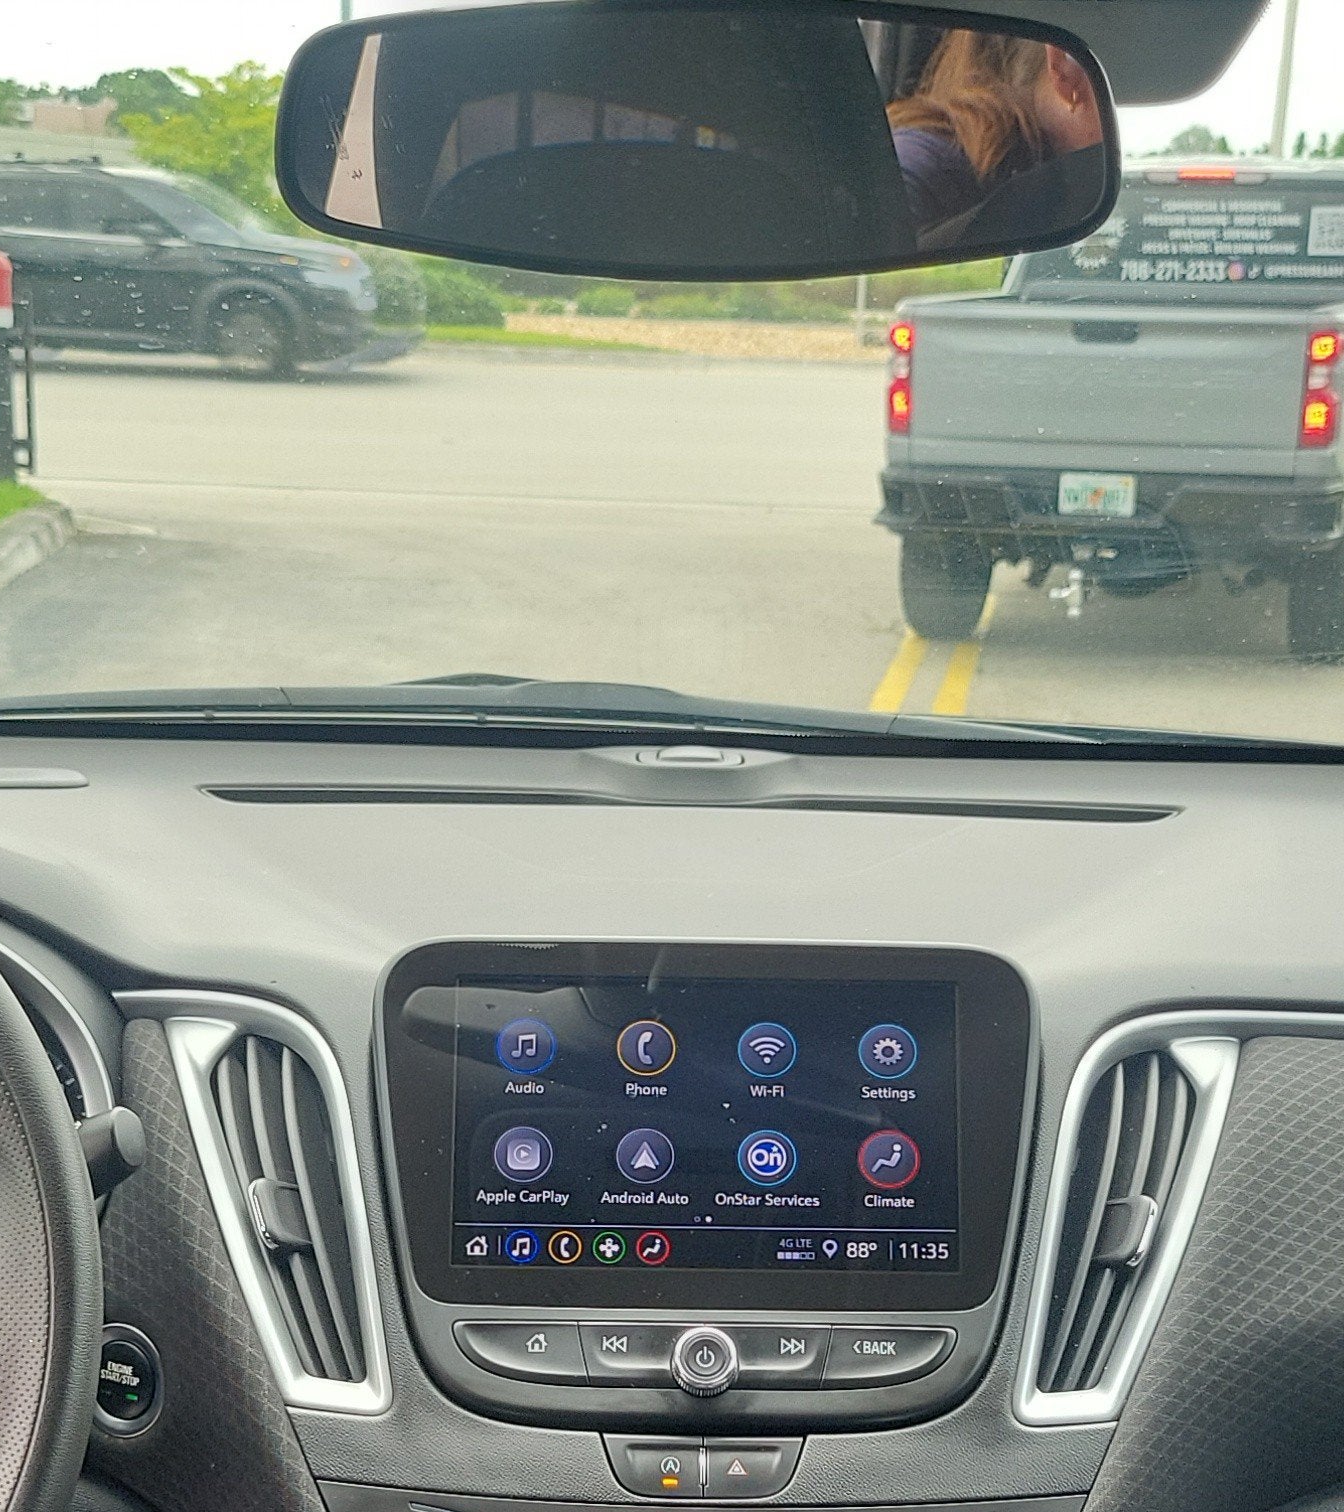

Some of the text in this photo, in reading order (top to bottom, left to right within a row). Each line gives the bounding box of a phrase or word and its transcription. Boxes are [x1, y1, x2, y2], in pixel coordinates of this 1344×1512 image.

[505, 1081, 545, 1096] Audio
[625, 1083, 668, 1097] Phone
[750, 1085, 785, 1099] Wi-Fi
[861, 1086, 917, 1101] Settings
[476, 1189, 569, 1206] Apple CarPlay
[601, 1191, 689, 1206] Android Auto
[715, 1193, 820, 1208] OnStar Services
[864, 1195, 915, 1208] Climate
[779, 1239, 813, 1249] 4G LTE
[898, 1242, 950, 1261] 11:35
